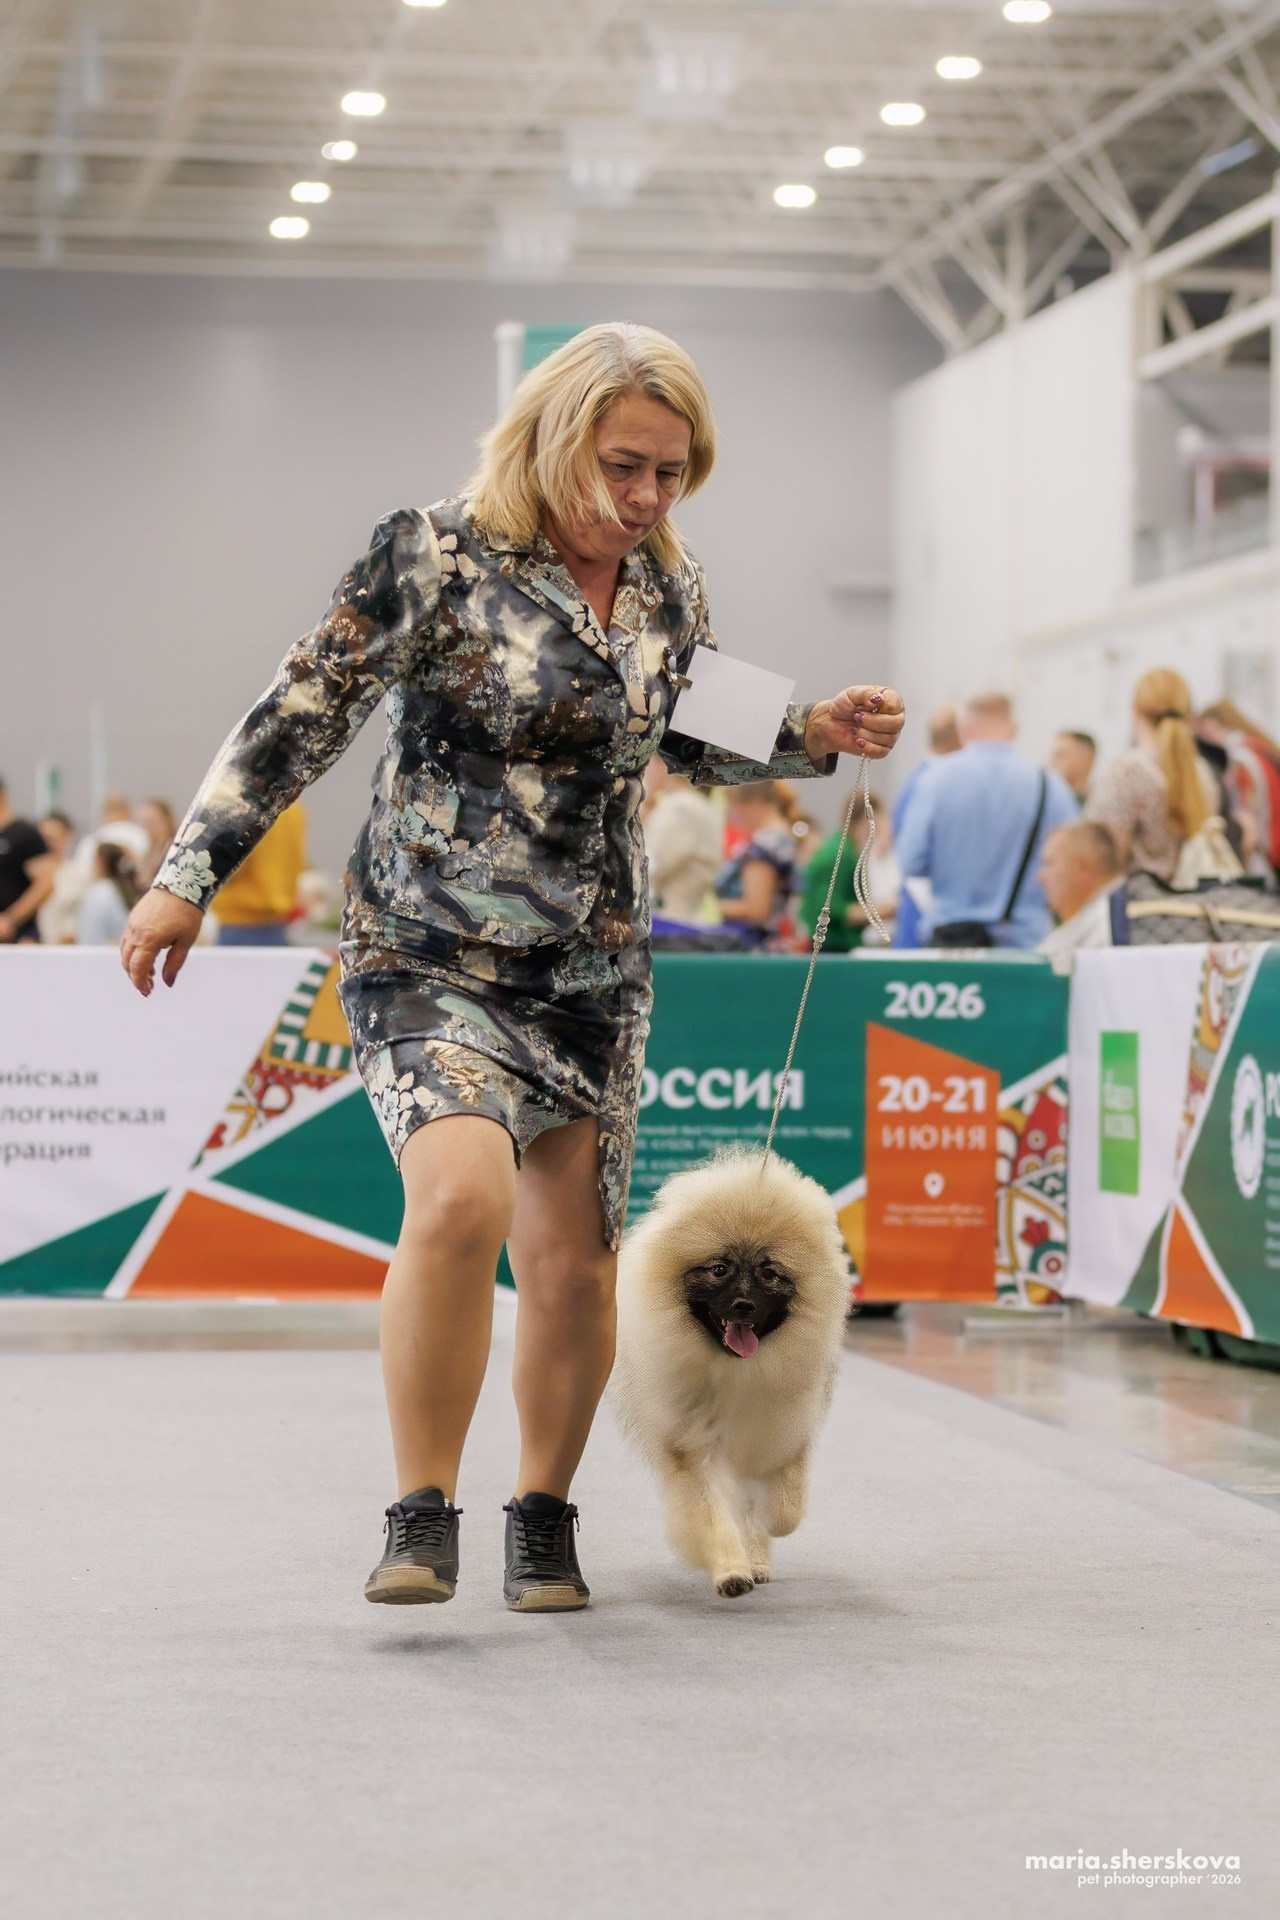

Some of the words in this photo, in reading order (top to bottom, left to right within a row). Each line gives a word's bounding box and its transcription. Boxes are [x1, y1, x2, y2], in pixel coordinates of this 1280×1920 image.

[884, 981, 985, 1019] 2026
[878, 1075, 986, 1113] 20-21
[882, 1125, 986, 1150] ИЮНЯ
[0, 1143, 91, 1166] рация
